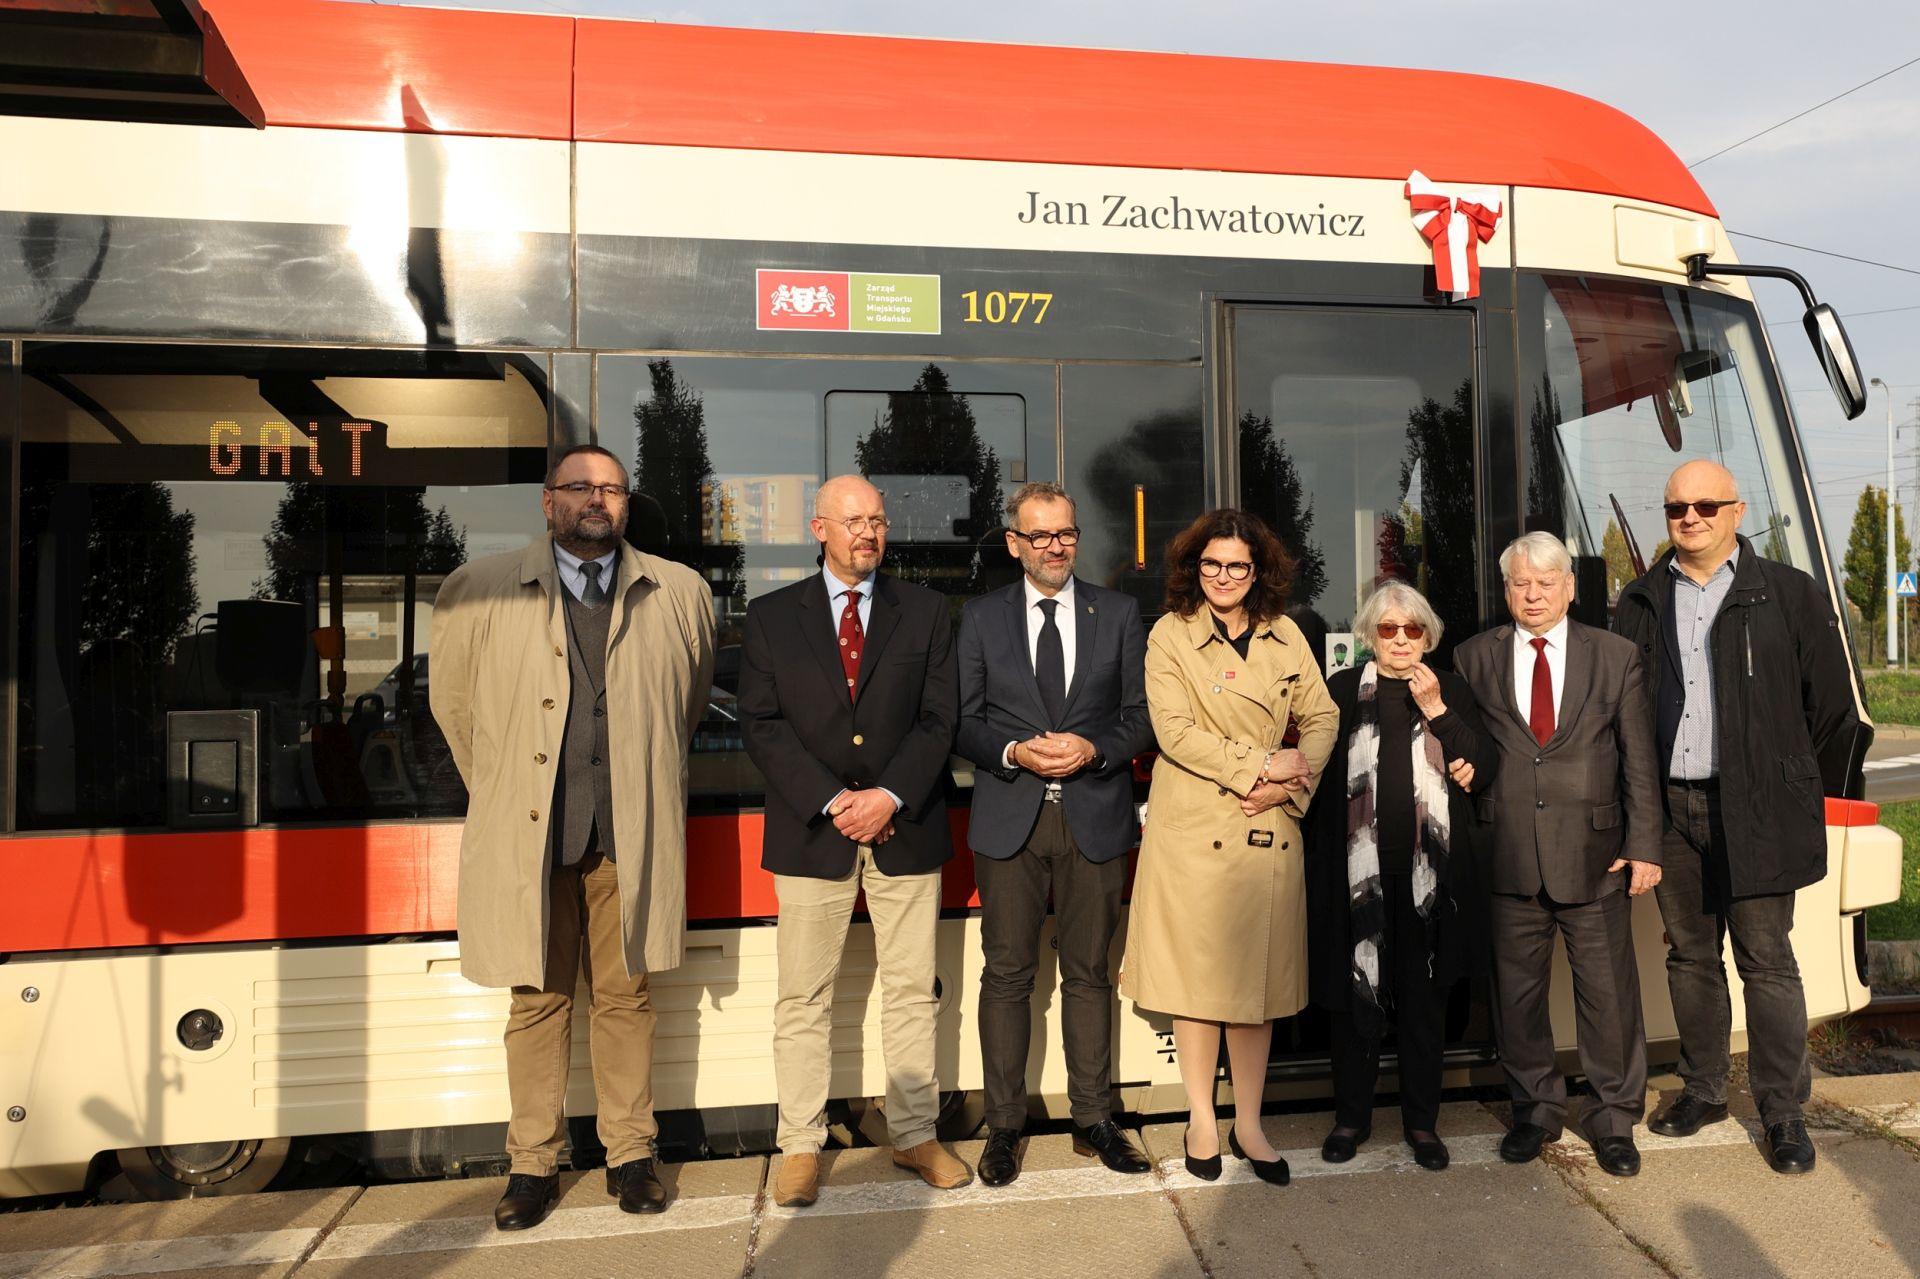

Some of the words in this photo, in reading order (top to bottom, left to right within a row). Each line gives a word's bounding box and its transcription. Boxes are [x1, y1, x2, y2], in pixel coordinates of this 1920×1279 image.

[1018, 191, 1090, 226] Jan
[1101, 194, 1365, 237] Zachwatowicz
[866, 283, 895, 293] Zarząd
[866, 294, 912, 303] Transportu
[866, 304, 911, 314] Miejskiego
[961, 290, 1053, 324] 1077
[875, 314, 912, 323] Gdańsku
